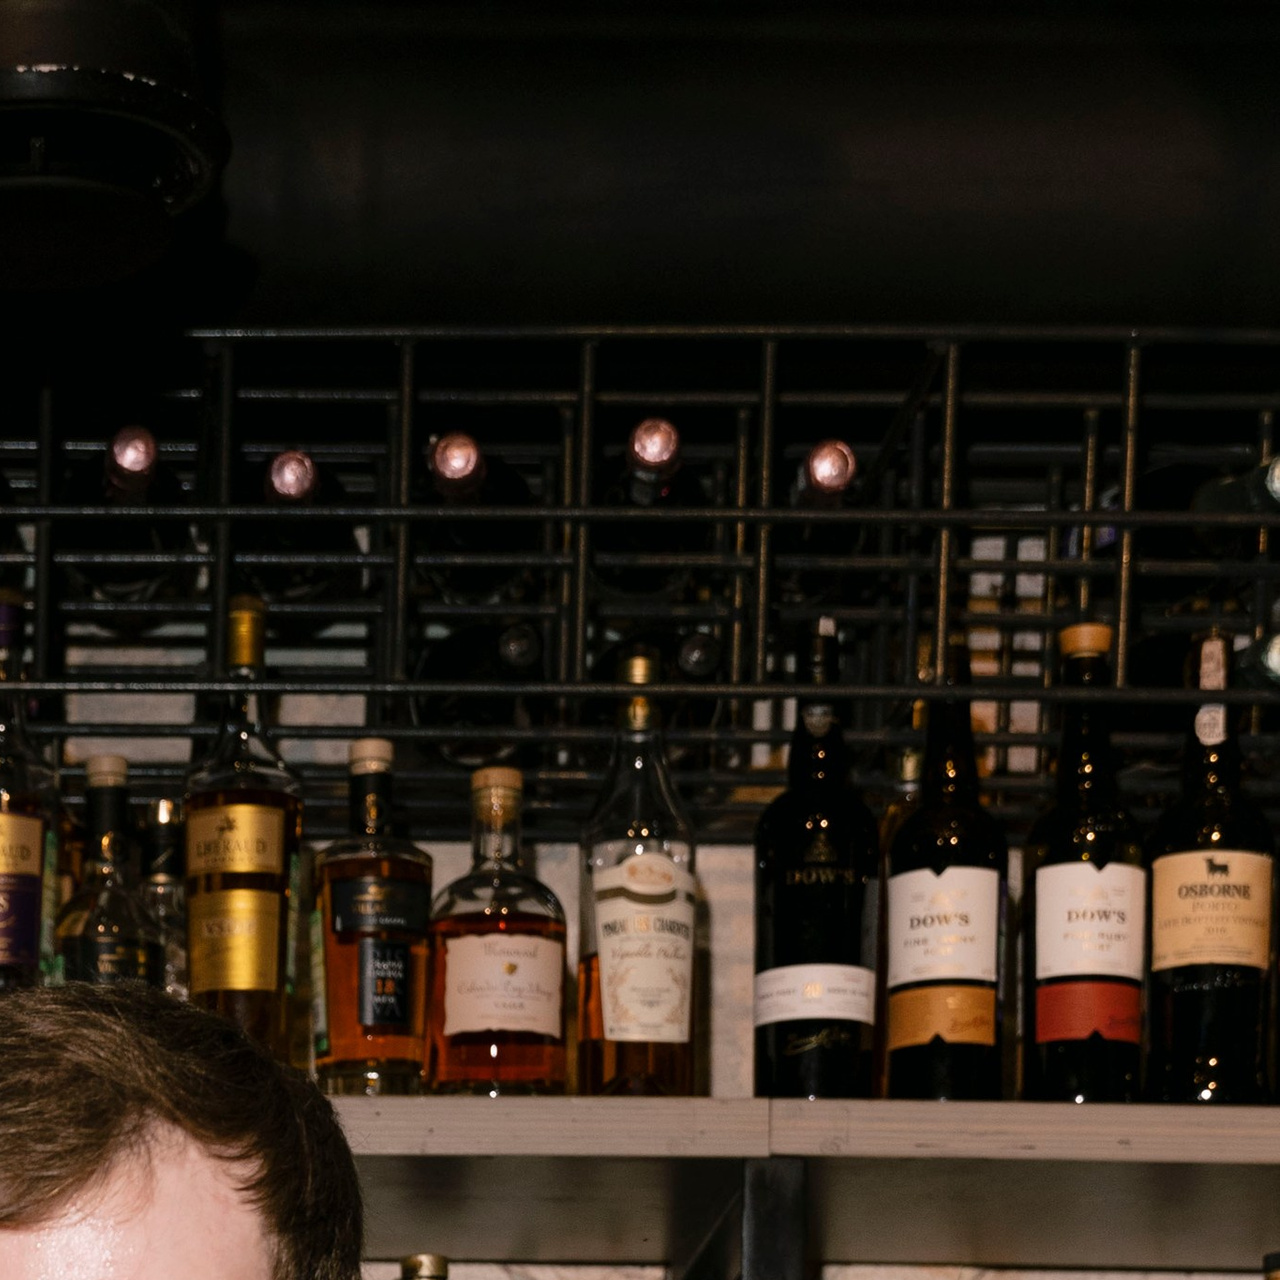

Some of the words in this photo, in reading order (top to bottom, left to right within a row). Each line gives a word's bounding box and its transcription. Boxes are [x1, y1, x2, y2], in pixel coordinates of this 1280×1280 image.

[1177, 884, 1251, 900] OSBORNE
[909, 912, 971, 930] DOW'S
[1067, 909, 1127, 925] DOW'S
